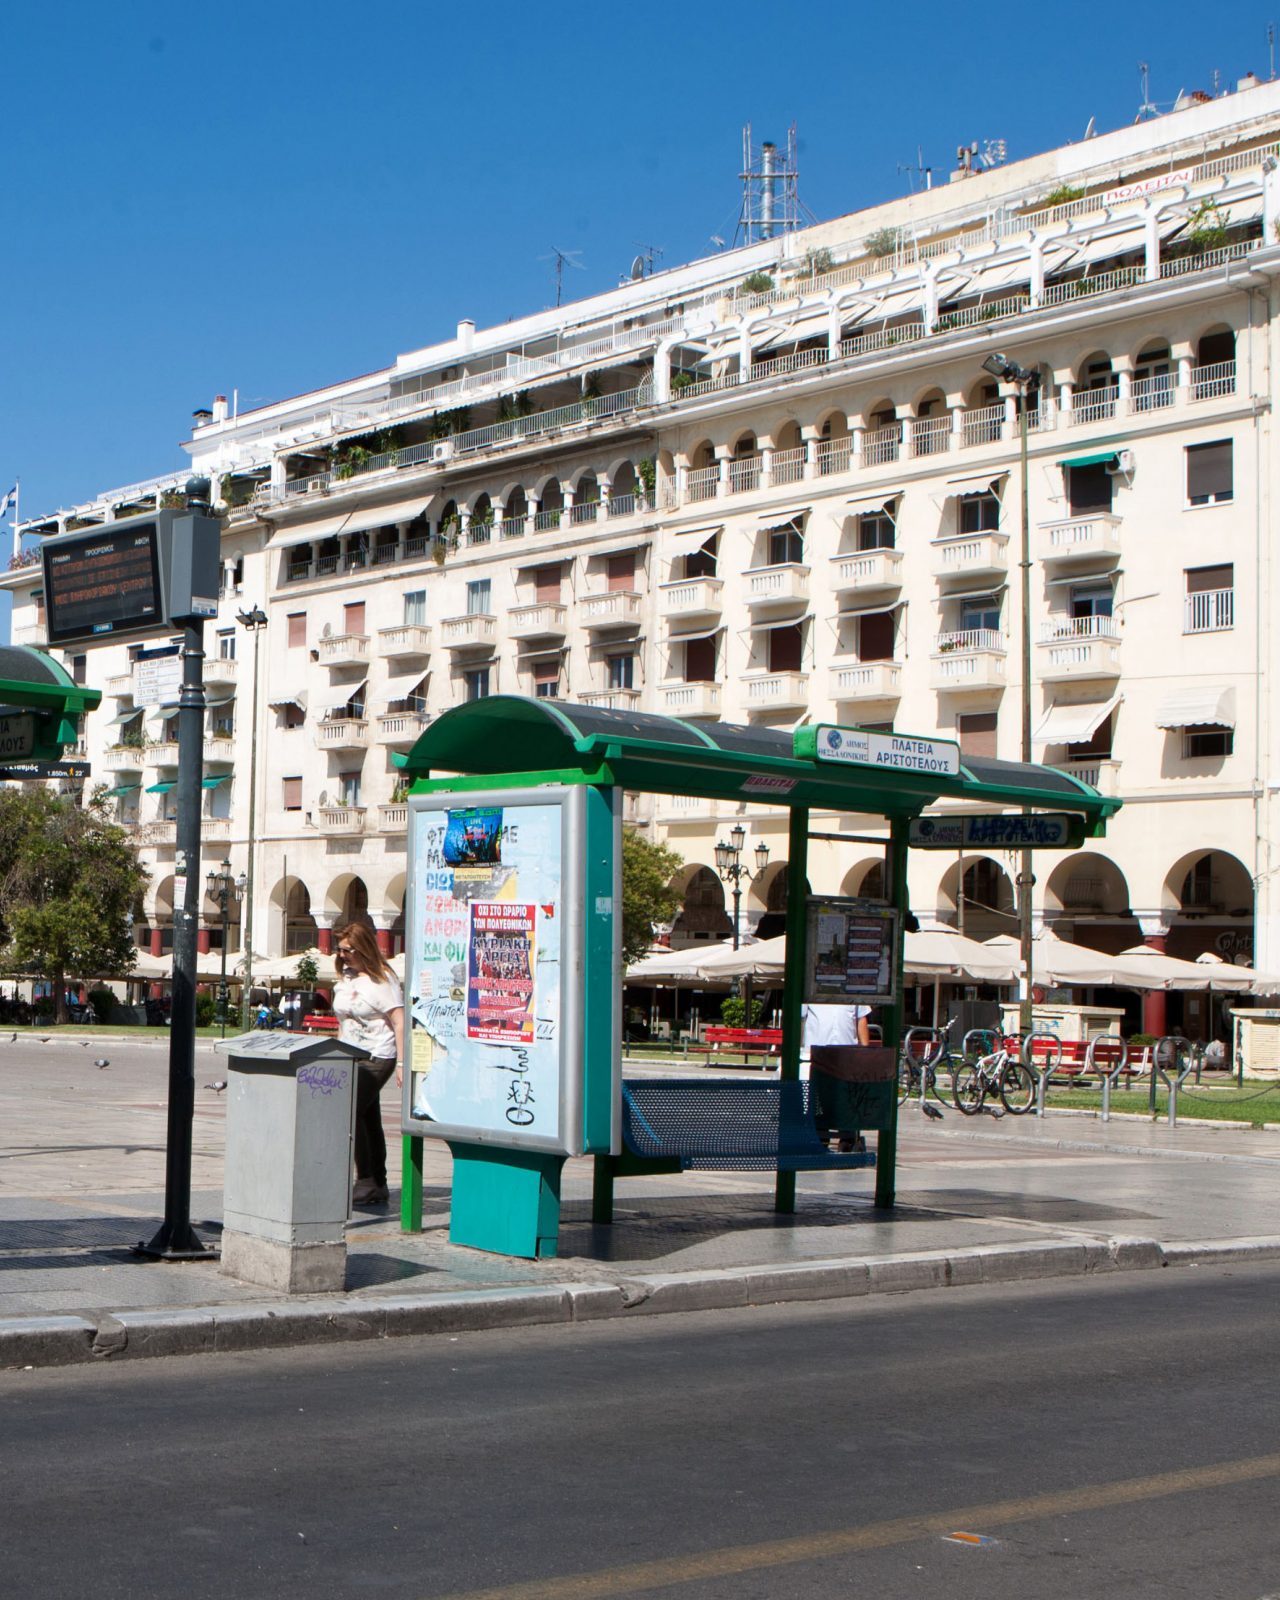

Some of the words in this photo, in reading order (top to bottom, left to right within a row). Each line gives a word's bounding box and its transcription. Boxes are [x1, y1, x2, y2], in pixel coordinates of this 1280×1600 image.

[1106, 172, 1189, 201] ΠΩΛΕΙΤΑΙ
[846, 740, 868, 750] ΔΗΜΟΣ
[891, 739, 934, 755] ΠΛΑΤΕΙΑ
[818, 749, 869, 762] ΘΕΣΣΑΛΟΝΙΚΗΣ
[876, 751, 949, 772] ΑΡΙΣΤΟΤΕΛΟΥΣ
[478, 905, 489, 917] ΟΧΙ
[490, 905, 502, 917] ΣΤΟ
[503, 906, 527, 917] ΩΡΑΡΙΟ
[473, 917, 486, 929] ΤΩΝ
[472, 937, 532, 951] ΚΥΡΙΑΚΗ
[482, 951, 521, 963] ΑΡΓΙΑ
